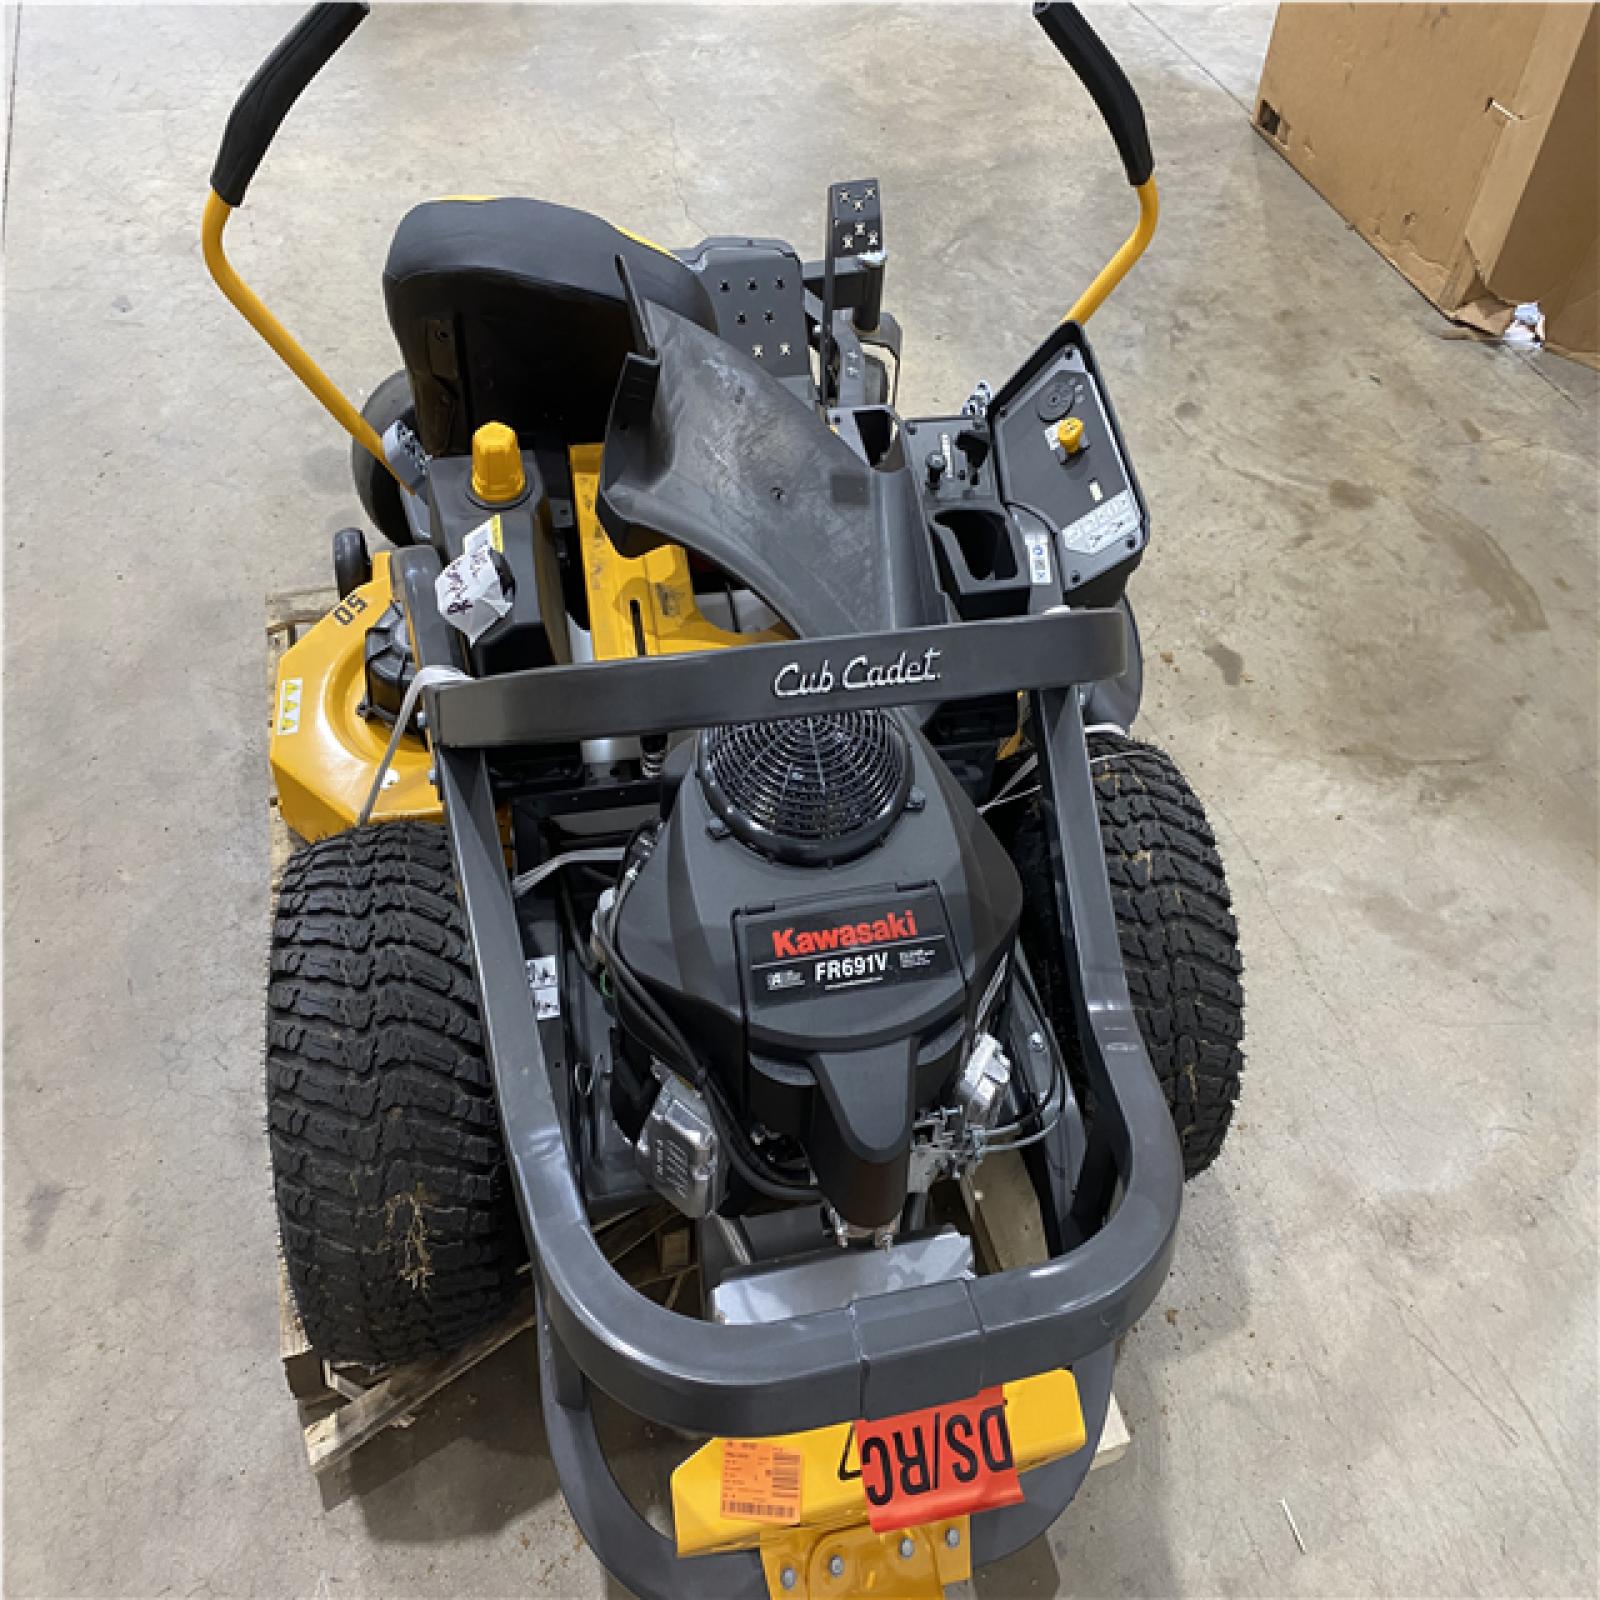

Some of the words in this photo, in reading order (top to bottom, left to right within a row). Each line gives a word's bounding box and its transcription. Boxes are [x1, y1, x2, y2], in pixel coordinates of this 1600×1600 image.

[774, 661, 834, 697] Cub
[843, 647, 941, 690] Cadet
[772, 909, 918, 958] Kawasaki
[815, 952, 889, 983] FR691V
[861, 1404, 1014, 1506] DS/RC
